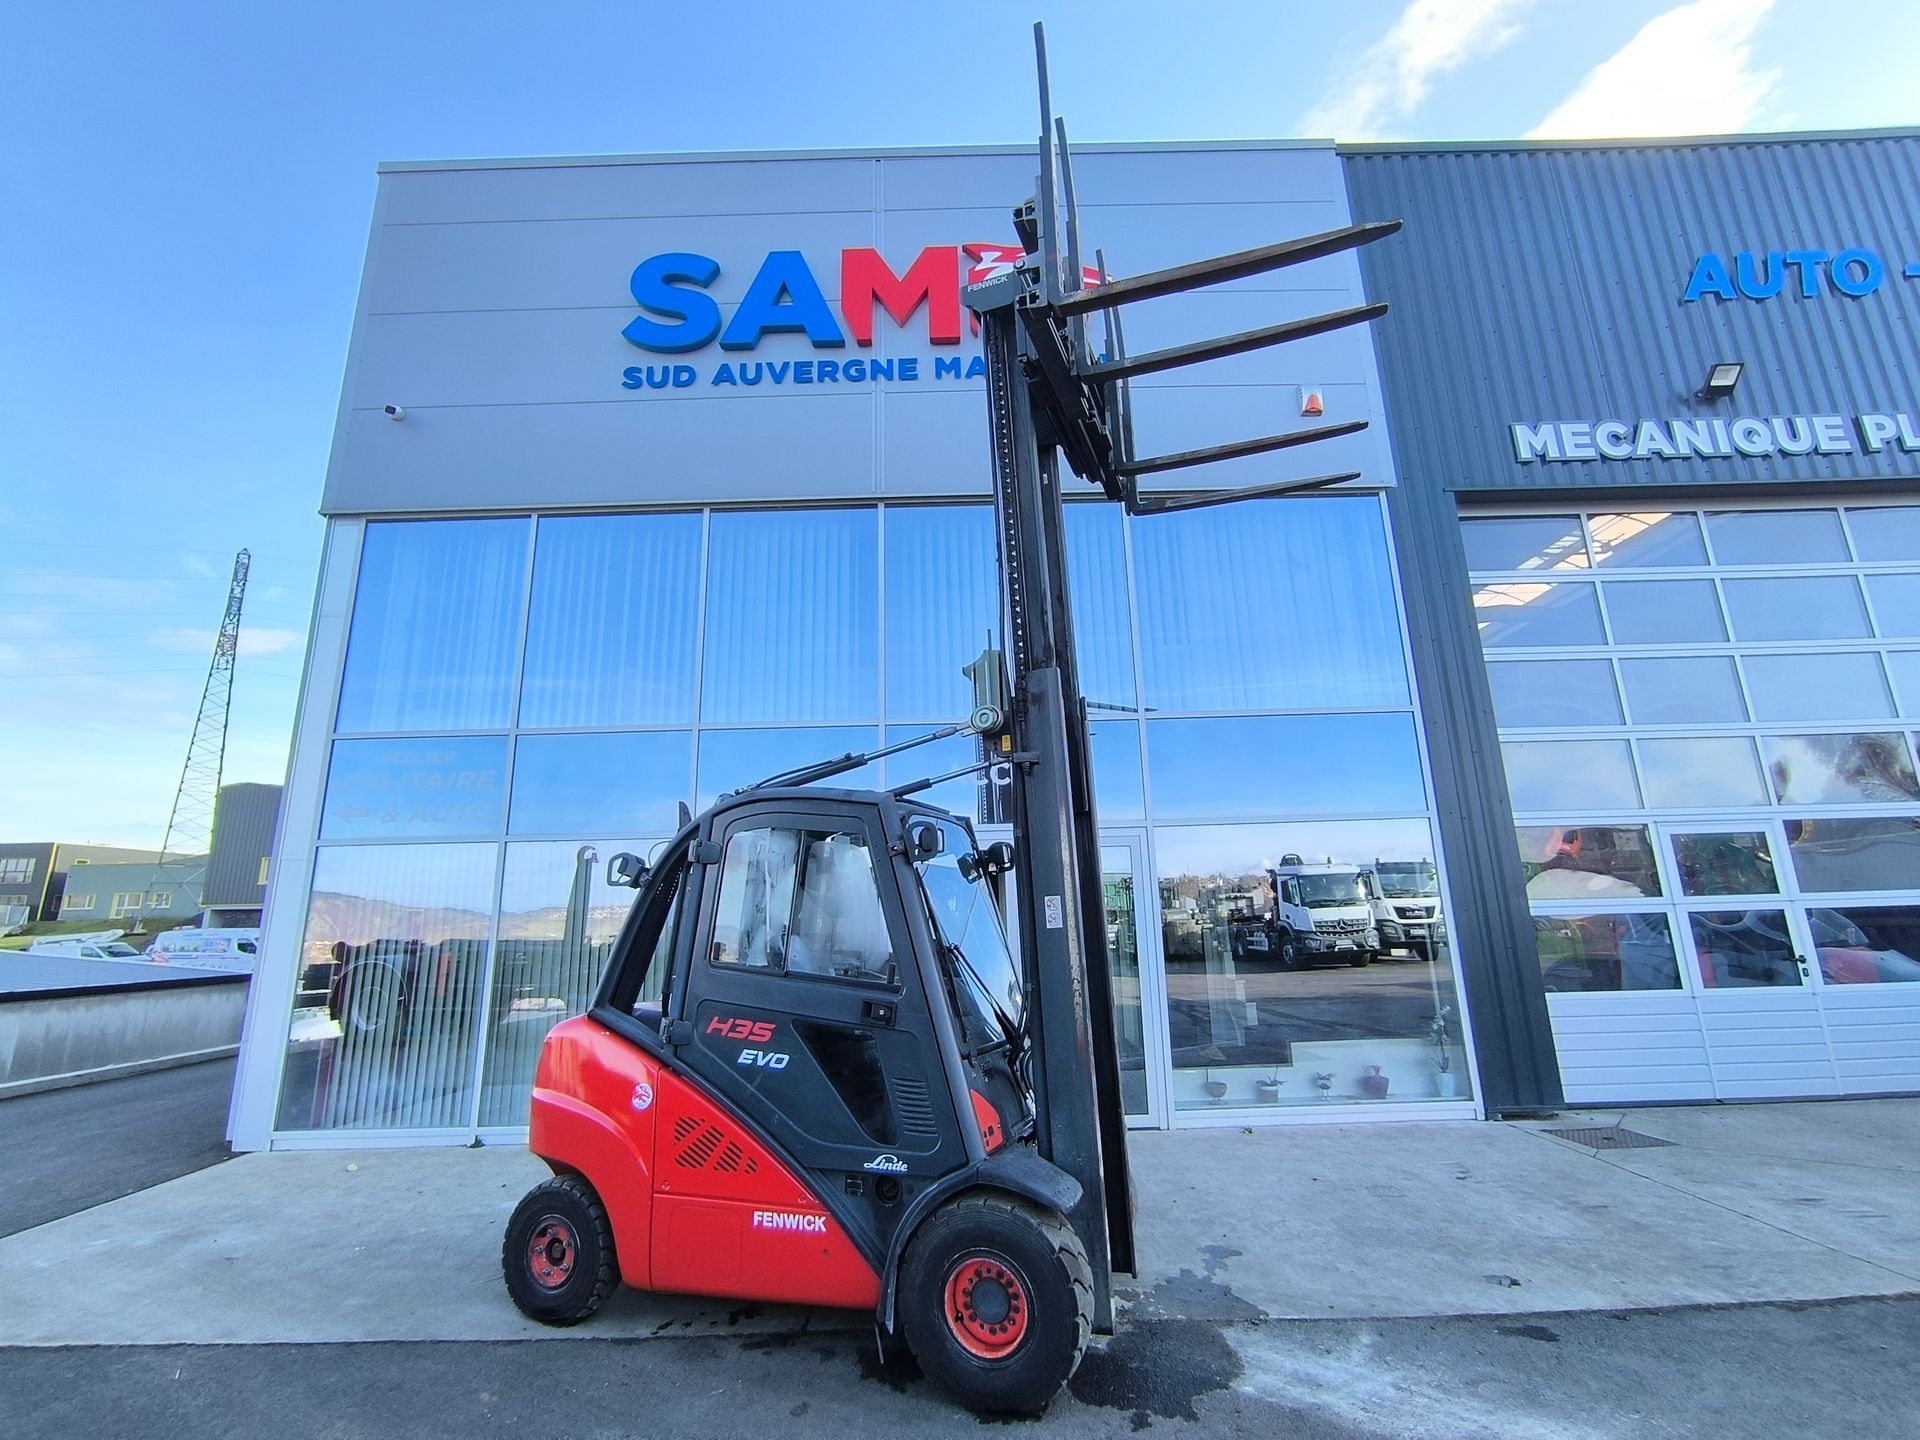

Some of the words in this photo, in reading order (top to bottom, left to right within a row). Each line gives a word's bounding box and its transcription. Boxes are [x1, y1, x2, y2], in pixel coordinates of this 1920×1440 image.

[967, 274, 1009, 293] FENWICK
[1684, 249, 1886, 301] AUTO
[622, 364, 697, 390] SUD
[711, 357, 919, 386] AUVERGNE
[1512, 414, 1854, 461] MECANIQUE
[706, 1016, 776, 1043] H35
[737, 1049, 790, 1069] EVO
[864, 1154, 908, 1172] Linde
[752, 1211, 827, 1232] FENWICK
